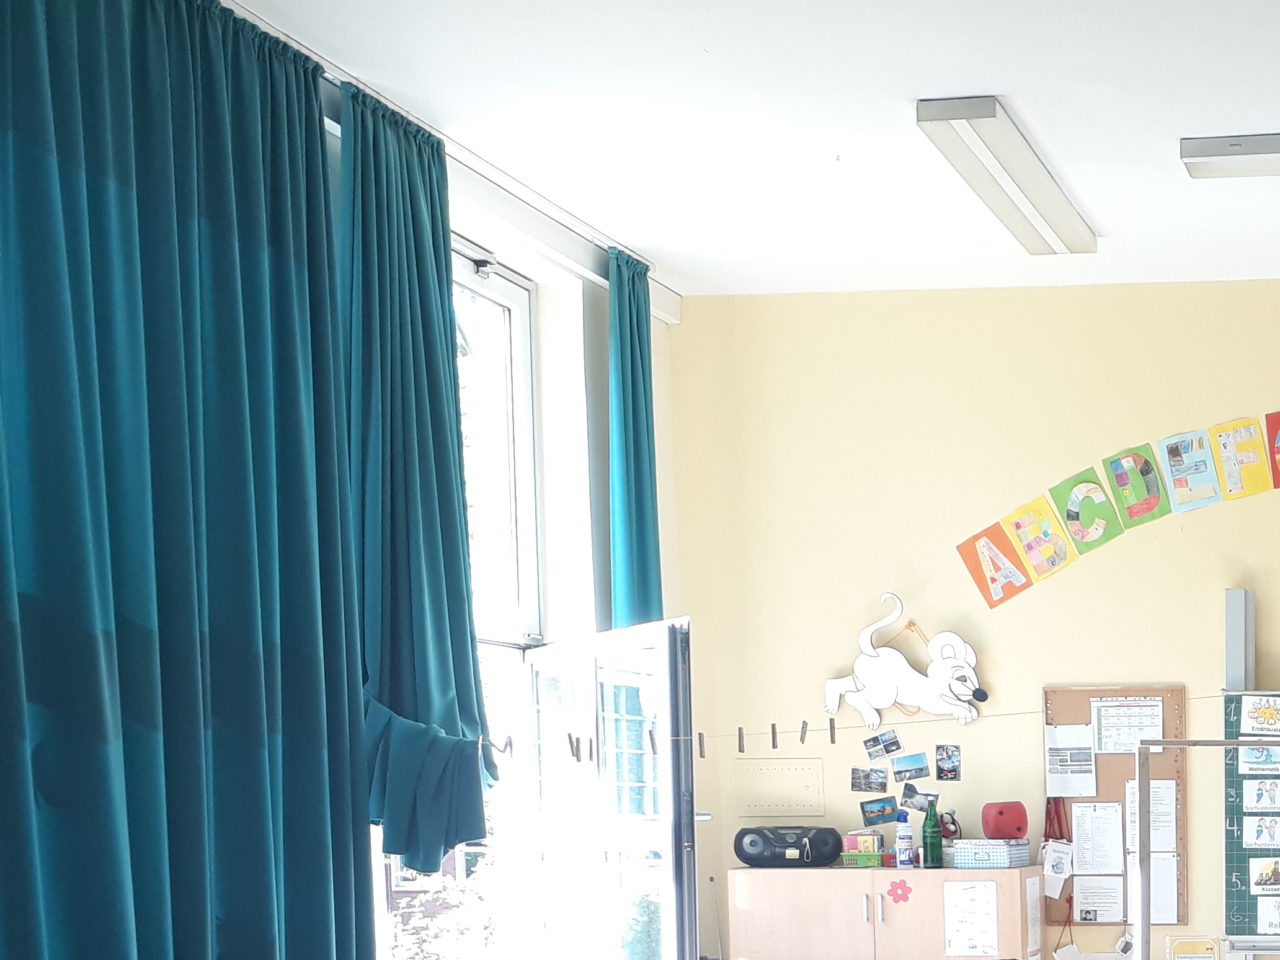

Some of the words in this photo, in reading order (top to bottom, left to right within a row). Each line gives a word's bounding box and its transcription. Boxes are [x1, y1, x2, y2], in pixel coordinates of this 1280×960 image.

[974, 536, 1027, 600] A
[1010, 511, 1069, 577] B
[1066, 482, 1107, 543] C
[1110, 453, 1161, 520] D
[1166, 436, 1217, 503] E
[1217, 424, 1258, 494] F
